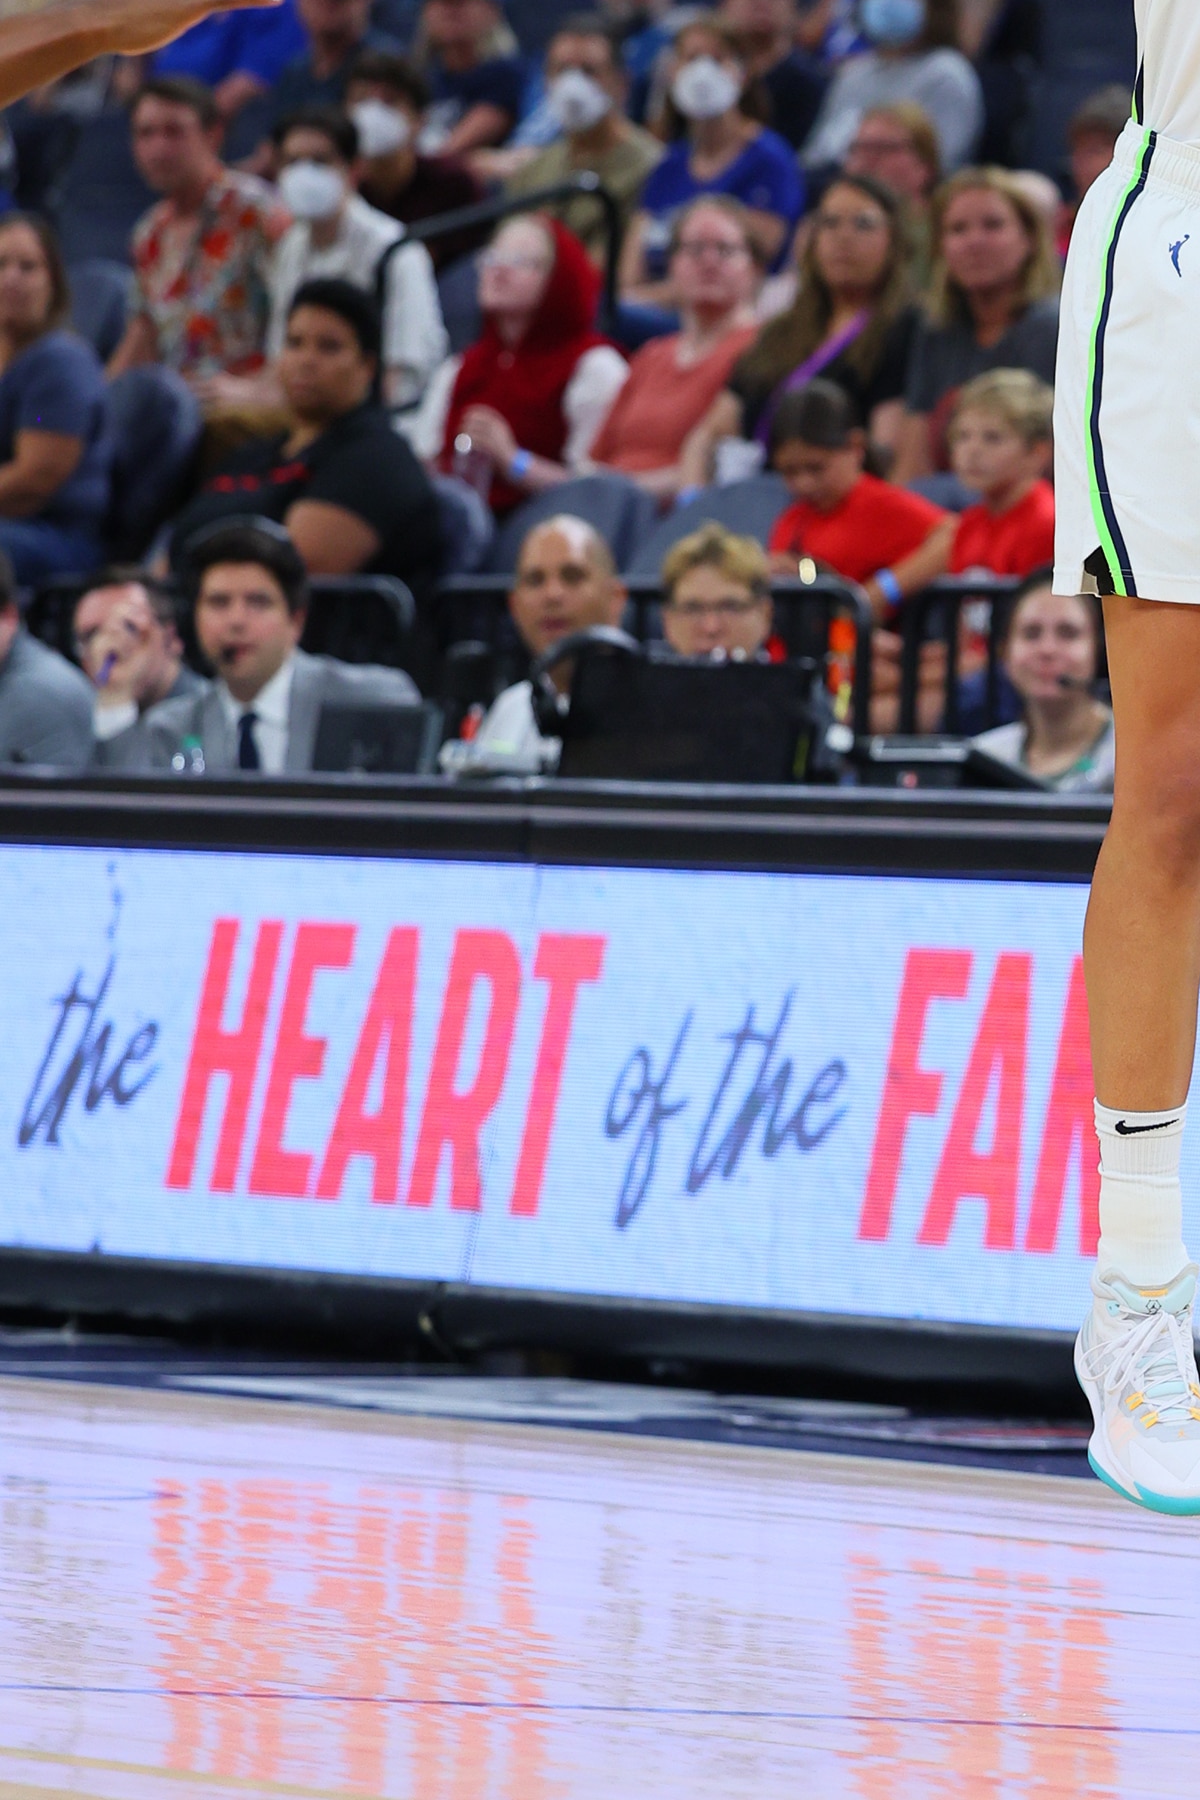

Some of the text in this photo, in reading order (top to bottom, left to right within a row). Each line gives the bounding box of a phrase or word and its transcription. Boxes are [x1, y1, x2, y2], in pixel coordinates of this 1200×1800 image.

[15, 948, 162, 1150] the
[163, 916, 608, 1218] HEART
[602, 1006, 690, 1234] of
[683, 985, 850, 1196] the
